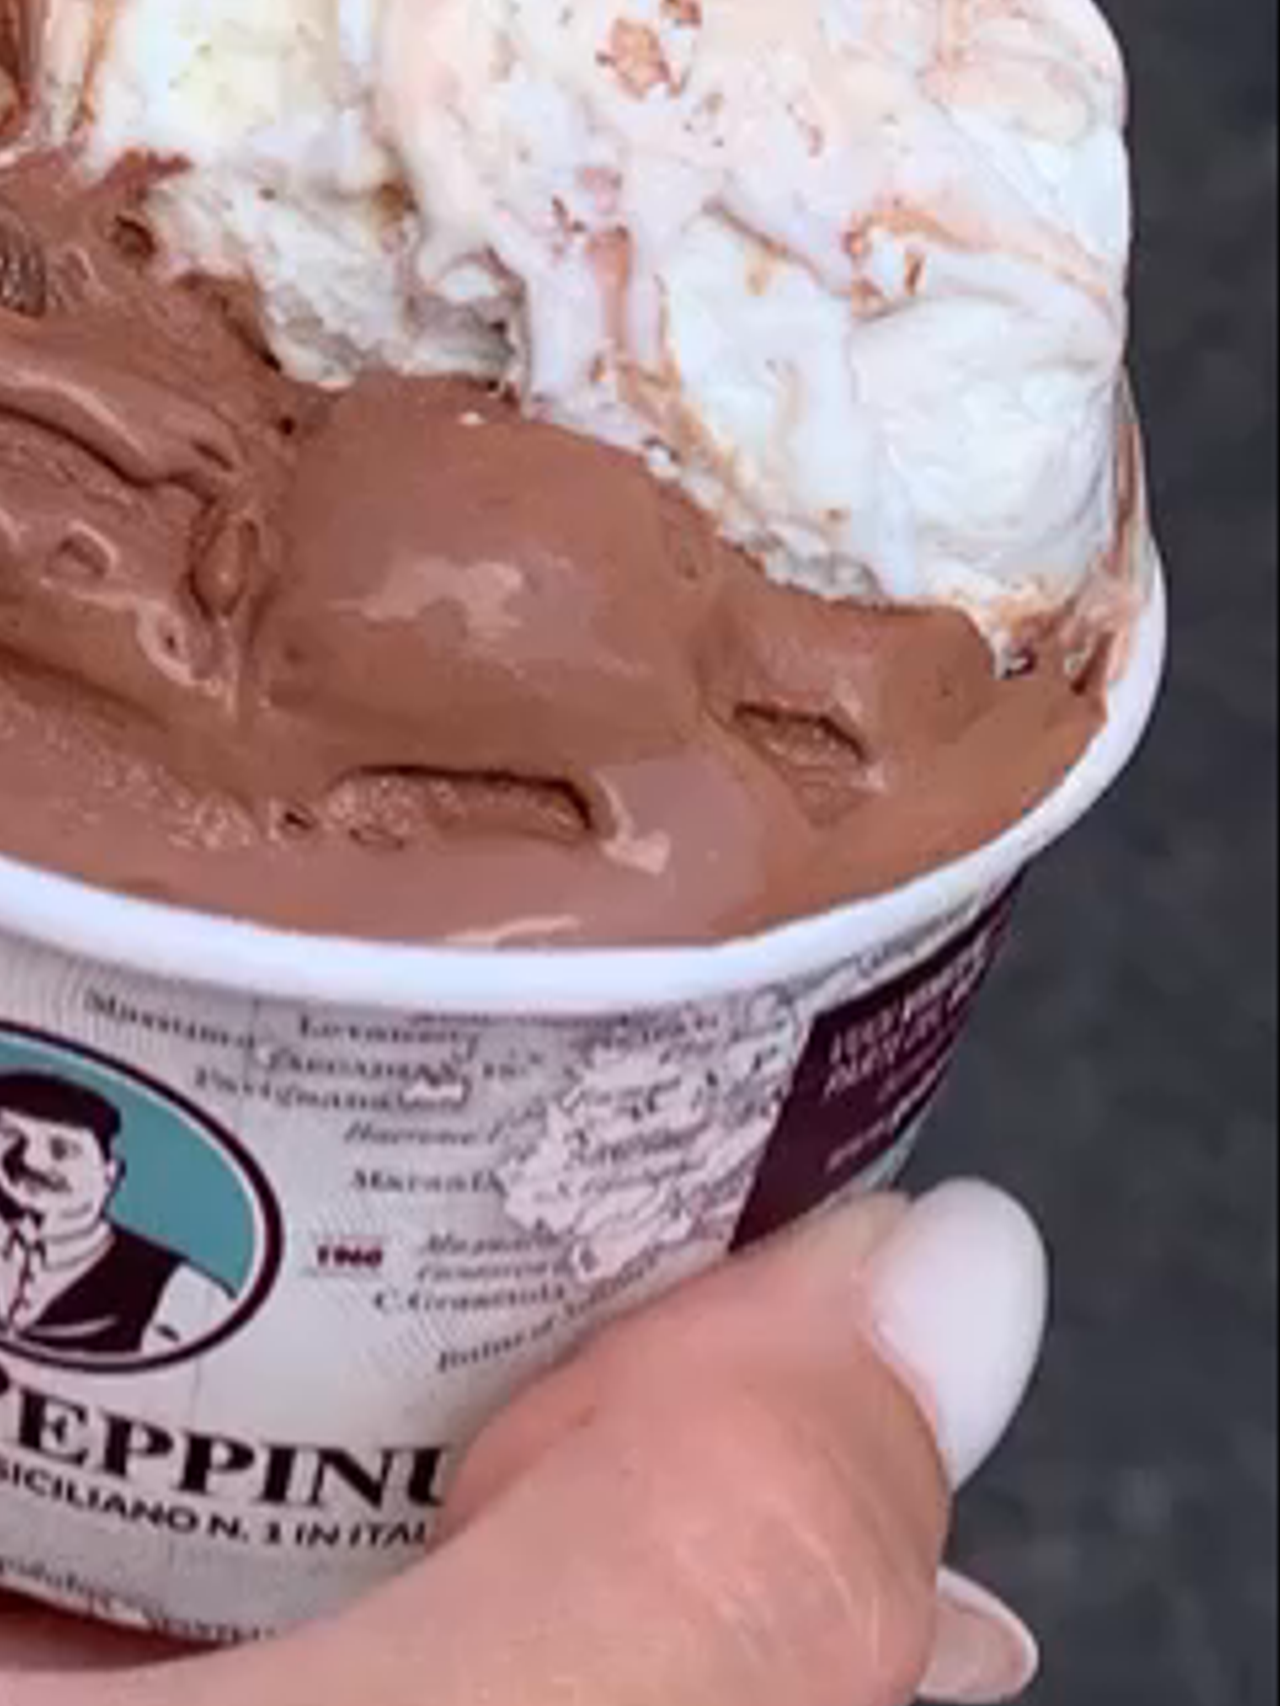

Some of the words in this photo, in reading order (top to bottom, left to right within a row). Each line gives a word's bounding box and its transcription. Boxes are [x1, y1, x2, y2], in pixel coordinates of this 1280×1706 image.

[206, 1509, 249, 1543] N.
[263, 1520, 283, 1547] 1
[293, 1520, 344, 1549] IN
